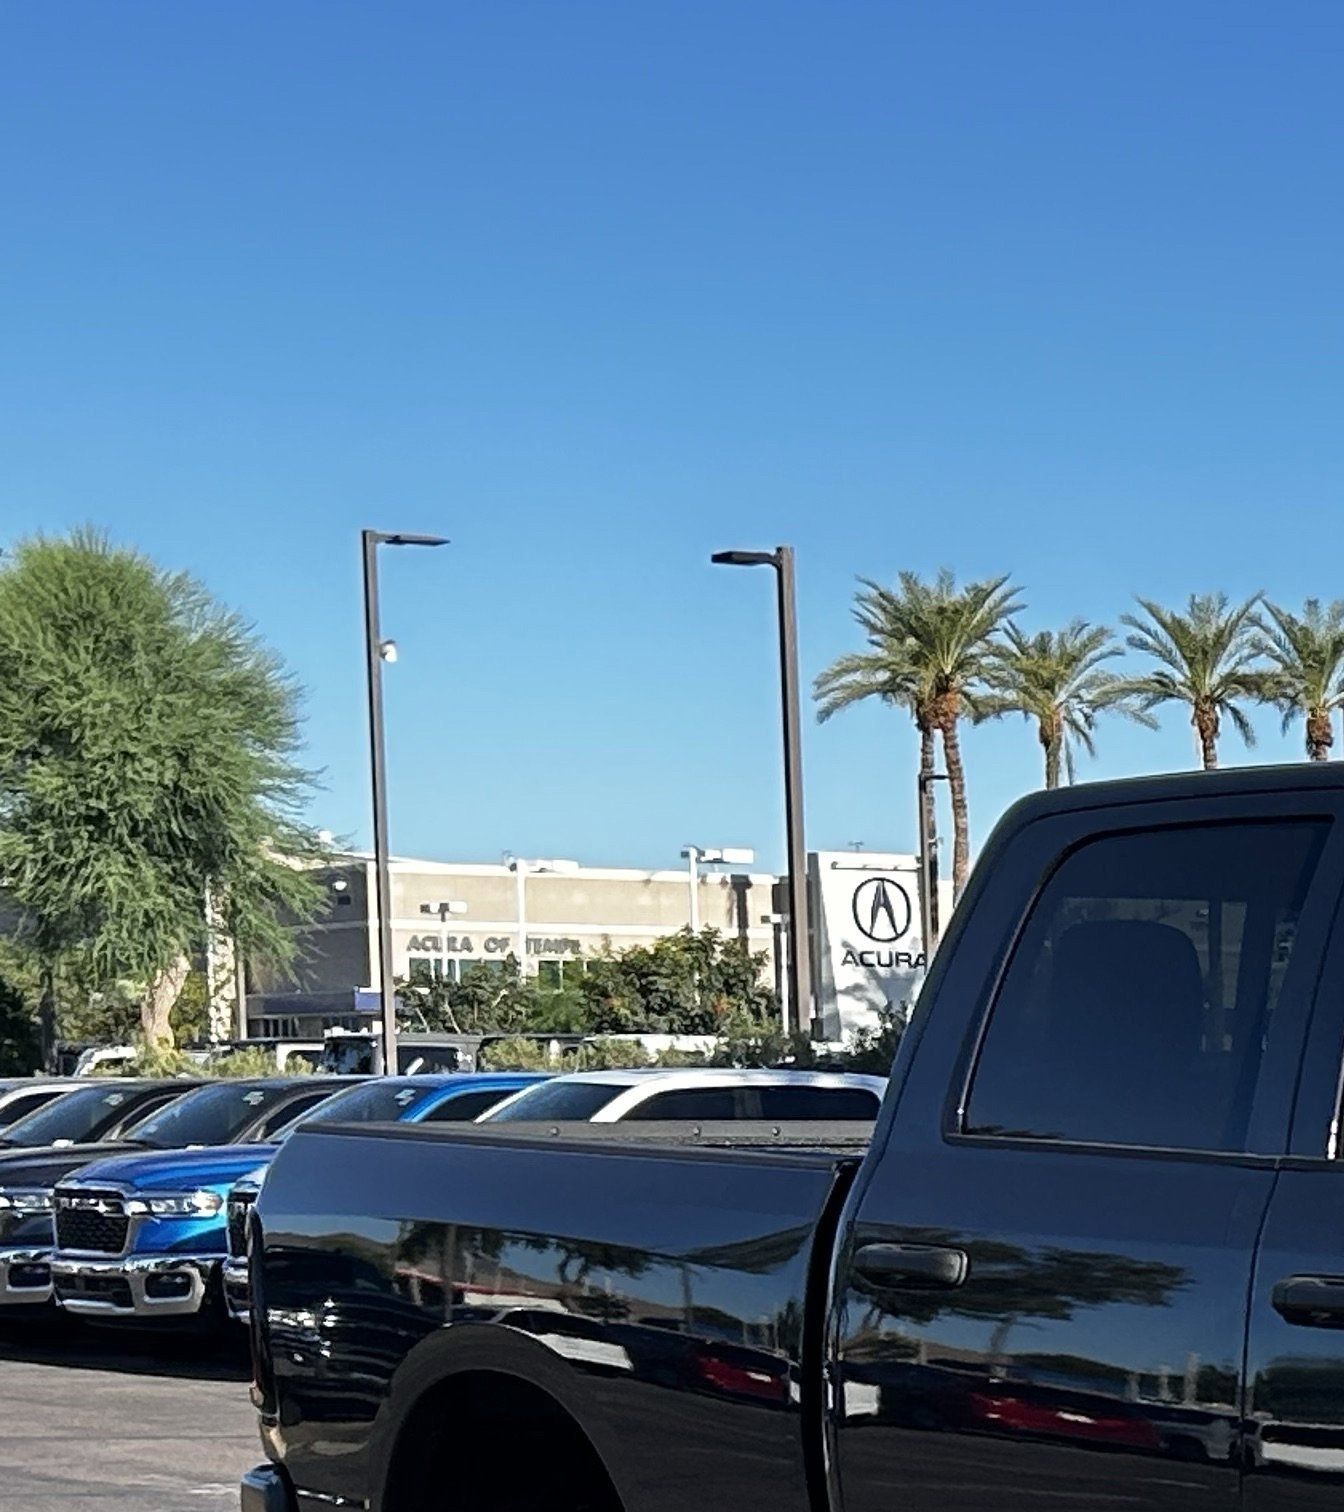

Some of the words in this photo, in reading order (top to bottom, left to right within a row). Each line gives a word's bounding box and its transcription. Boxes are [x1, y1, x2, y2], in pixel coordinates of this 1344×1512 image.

[407, 935, 473, 952] ACURA
[484, 937, 510, 953] OF
[841, 951, 927, 969] ACURA
